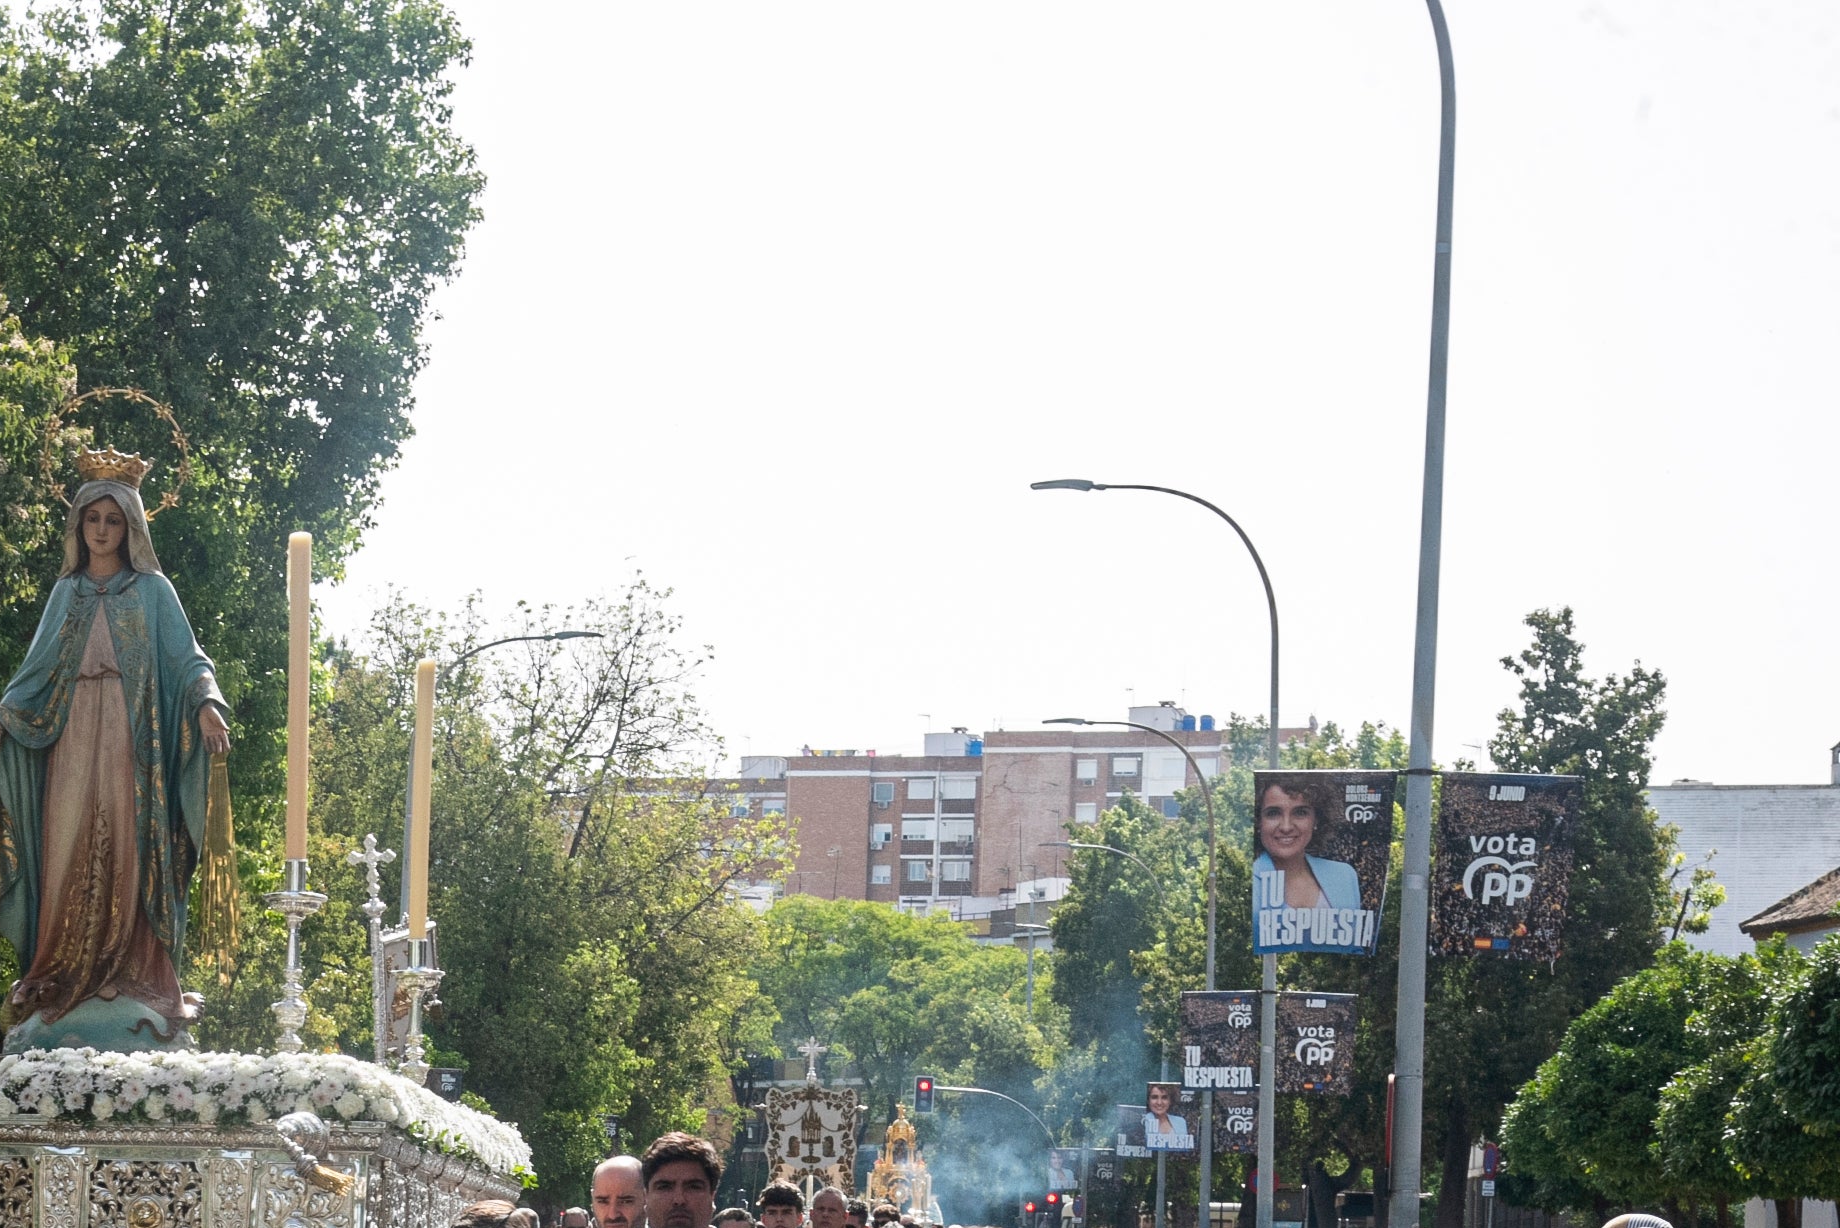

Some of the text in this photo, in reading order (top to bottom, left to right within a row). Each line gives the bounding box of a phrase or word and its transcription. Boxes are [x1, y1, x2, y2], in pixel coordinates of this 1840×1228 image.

[1470, 833, 1536, 855] vota
[1261, 870, 1285, 908] TU
[1259, 908, 1374, 947] RESPUESTA
[1228, 1003, 1252, 1012] vota
[1297, 1025, 1335, 1038] vota
[1185, 1046, 1201, 1067] TU
[1184, 1067, 1253, 1088] RESPUESTA
[1228, 1106, 1254, 1115] vota
